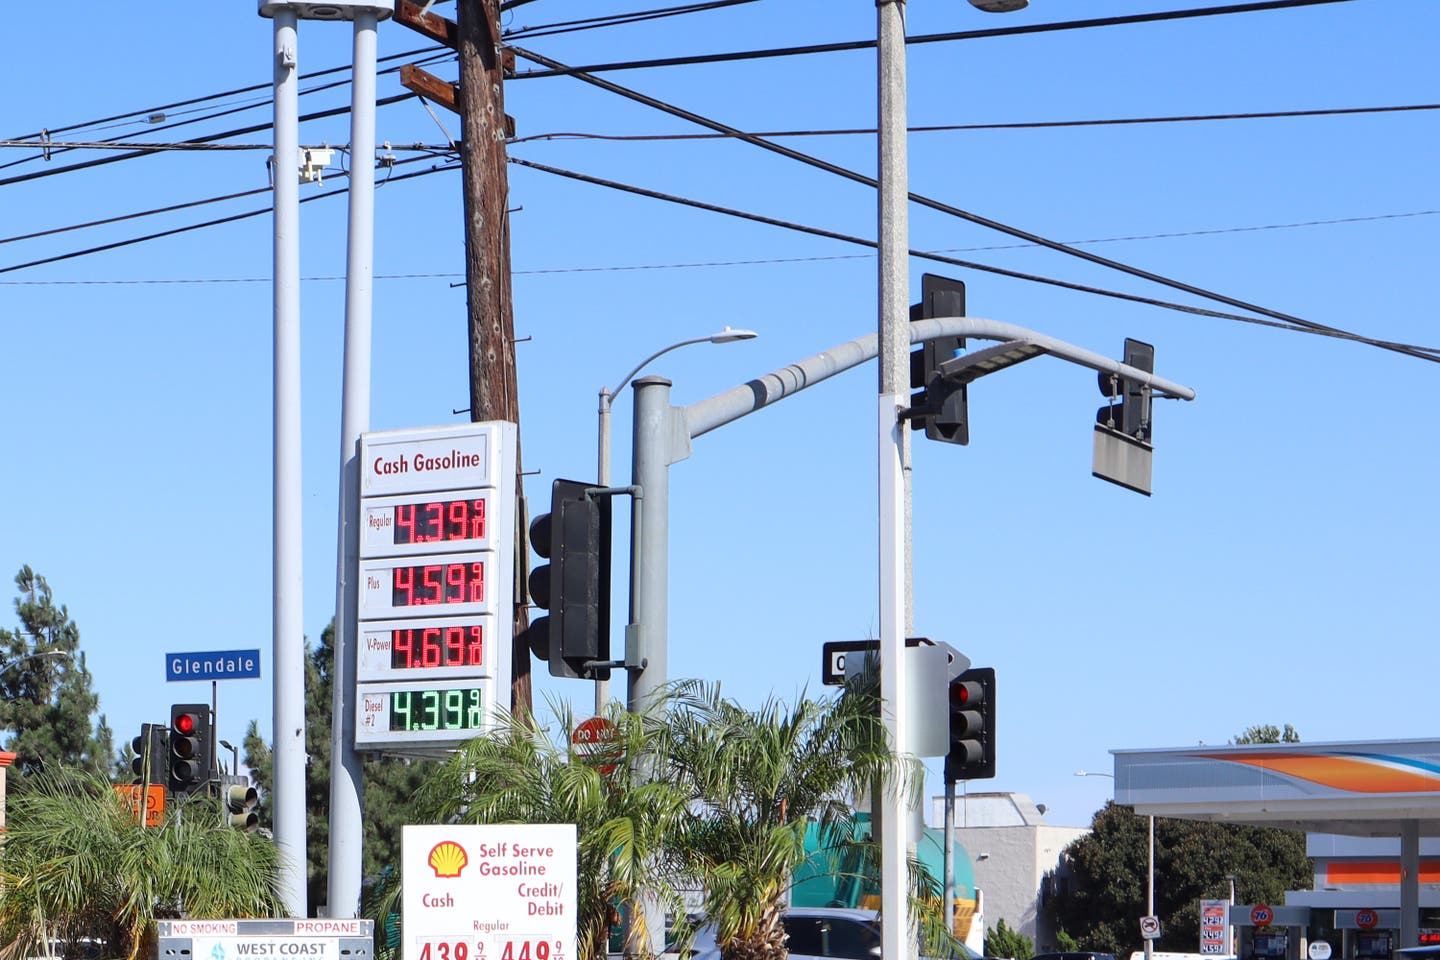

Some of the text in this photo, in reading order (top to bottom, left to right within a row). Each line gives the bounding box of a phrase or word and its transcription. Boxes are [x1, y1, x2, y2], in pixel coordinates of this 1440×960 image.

[374, 449, 480, 476] Cash Gasoline
[368, 513, 392, 530] Regular
[396, 501, 468, 544] 4.39
[367, 576, 380, 590] Plus
[396, 565, 466, 606] 4.59
[366, 636, 391, 652] V-Power
[395, 628, 465, 668] 4.69
[172, 657, 254, 675] Glendale
[365, 697, 383, 713] Diesel
[393, 691, 464, 731] 4.39
[365, 714, 376, 727] #2
[578, 729, 591, 740] DO
[479, 843, 553, 858] Self Serve
[479, 862, 546, 877] Gasoline
[422, 893, 454, 908] Cash
[527, 901, 564, 916] Debit
[1255, 911, 1268, 921] 76
[473, 919, 510, 933] Regular
[1359, 914, 1372, 924] 76
[173, 922, 237, 935] NO SMOKING
[296, 921, 359, 934] PROPANE
[237, 943, 326, 955] WEST COAST
